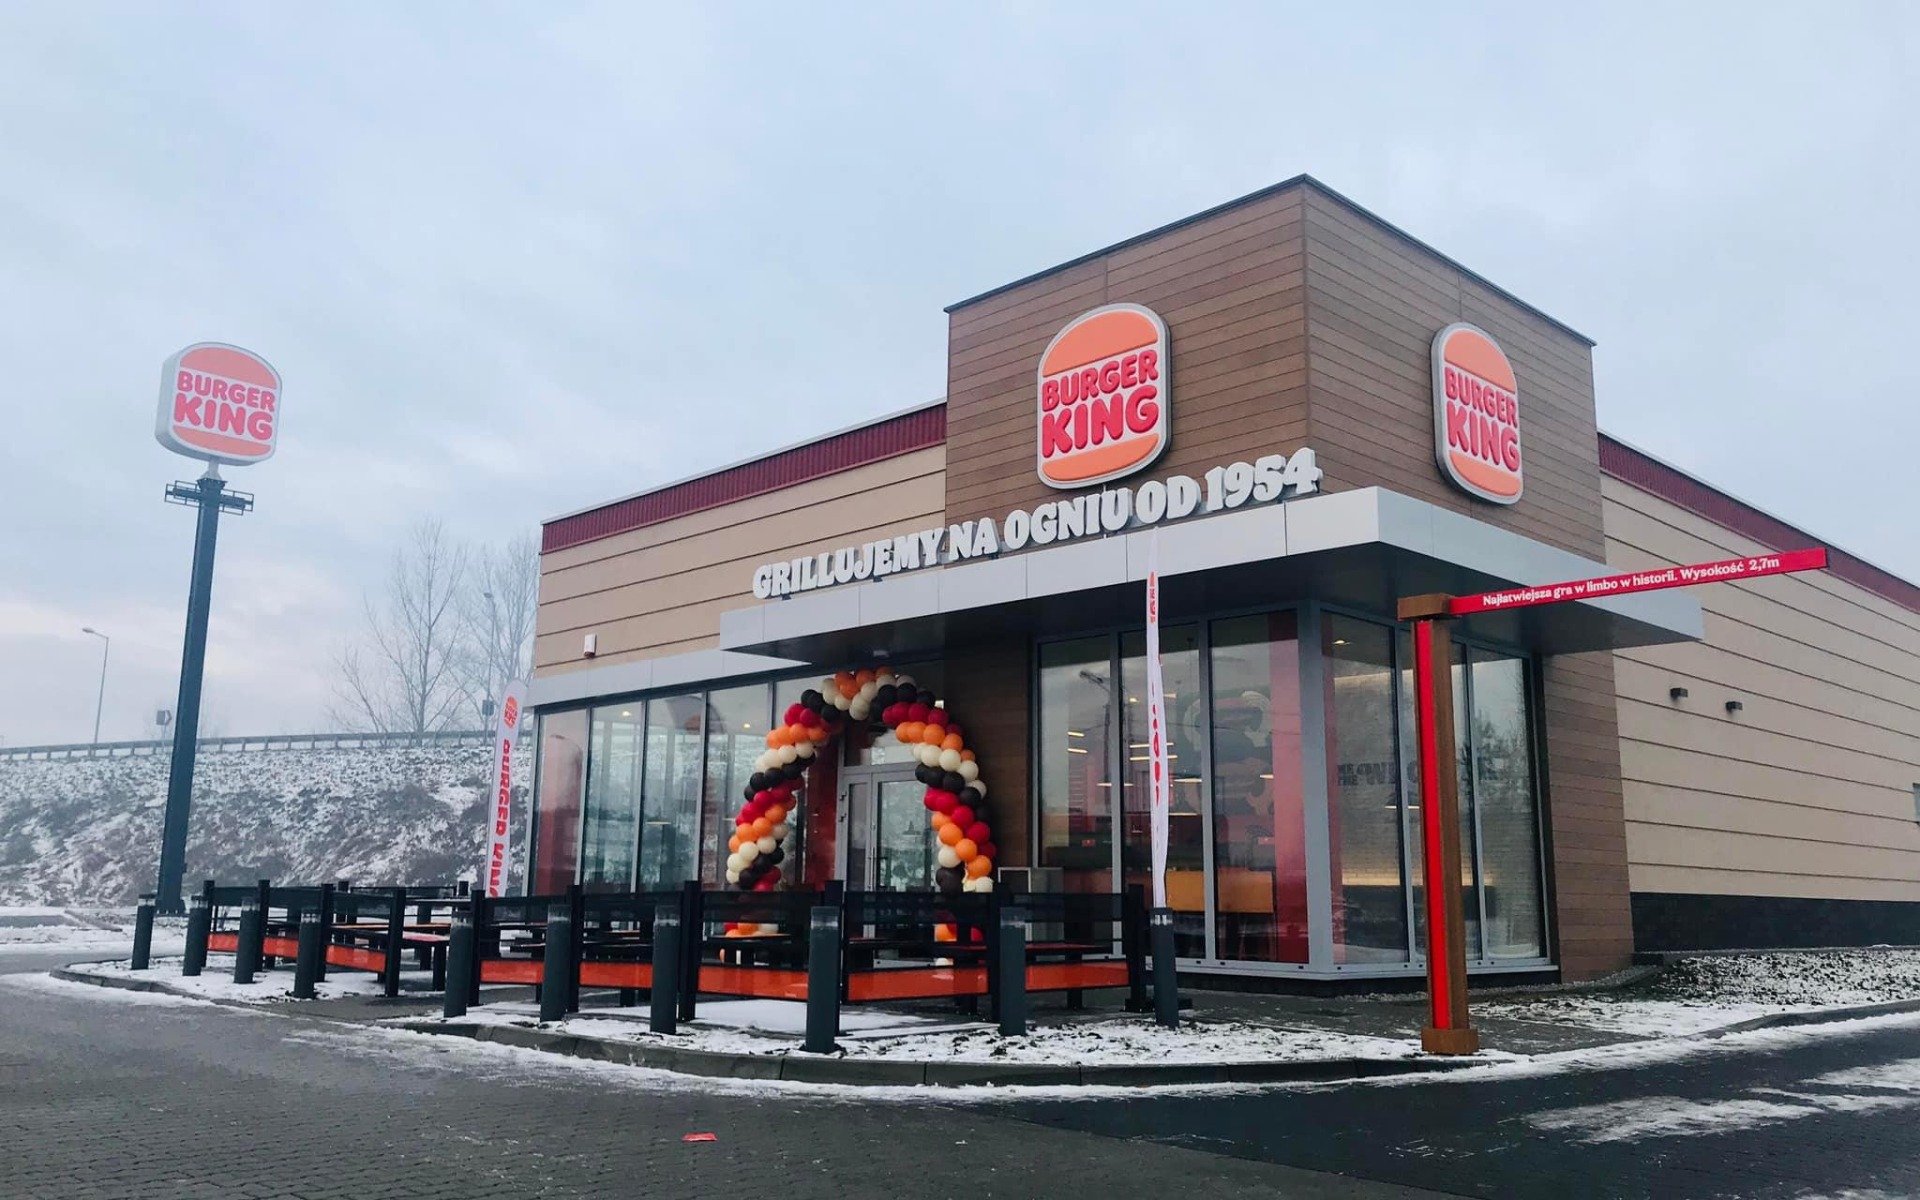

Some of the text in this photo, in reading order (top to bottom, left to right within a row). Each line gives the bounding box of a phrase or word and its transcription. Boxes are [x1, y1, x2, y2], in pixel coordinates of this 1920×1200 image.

[177, 370, 275, 412] BURGER
[1042, 349, 1159, 412] BURGER
[1444, 366, 1518, 428] BURGER
[174, 393, 273, 440] KING
[1042, 384, 1159, 458] KING
[1446, 400, 1520, 472] KING
[753, 447, 1323, 600] GRILLUJEMY NA OGNIU OD 1954
[1553, 586, 1573, 599] gra
[1574, 585, 1585, 593] w
[1586, 577, 1618, 592] limbo
[1620, 579, 1631, 588] w
[1633, 573, 1678, 587] historii.
[1680, 561, 1745, 582] Wysokość
[1748, 557, 1780, 573] 2,7m
